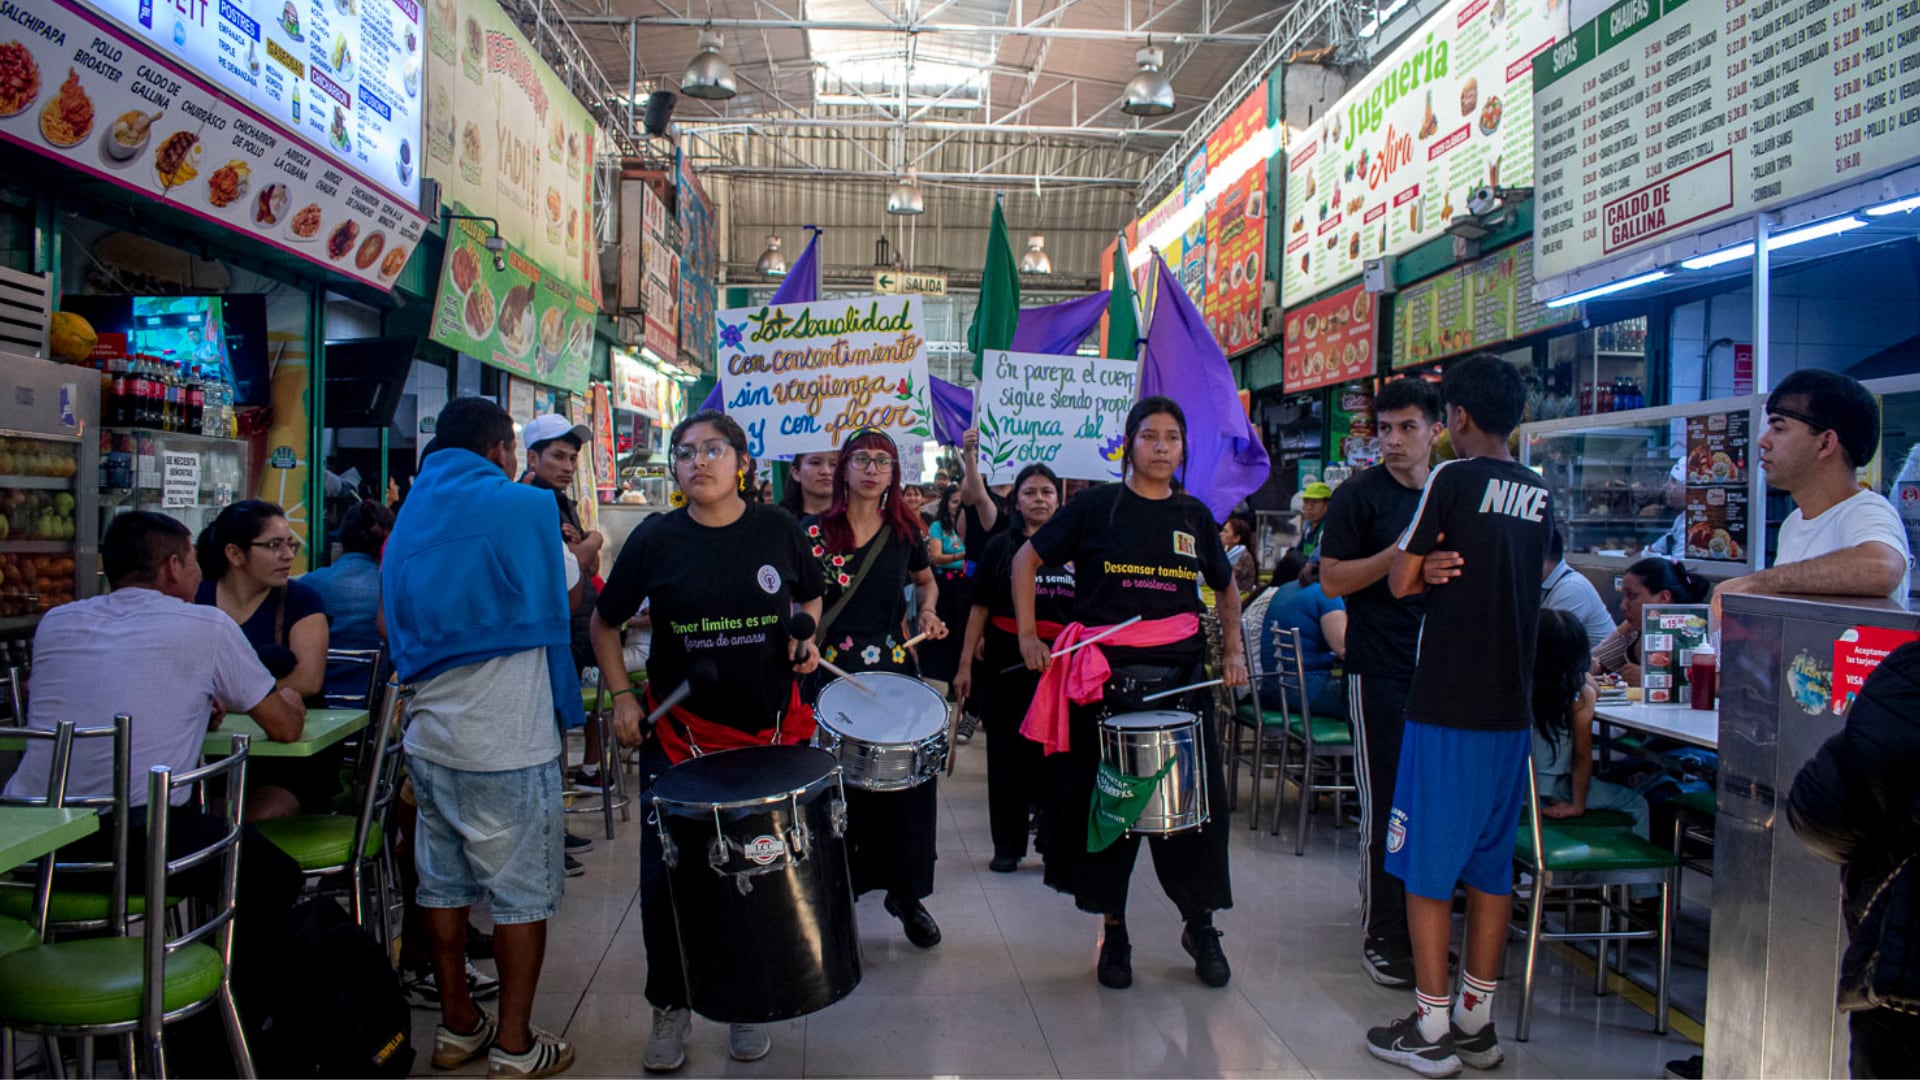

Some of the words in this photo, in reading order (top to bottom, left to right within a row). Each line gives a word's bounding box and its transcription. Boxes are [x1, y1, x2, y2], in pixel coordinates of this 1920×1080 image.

[0, 3, 66, 47] SALCHIPAPA
[220, 2, 255, 36] POSTRES
[91, 37, 123, 63] POLLO
[1553, 37, 1578, 73] SOPAS
[73, 49, 123, 83] BROASTER
[131, 81, 171, 110] GALLINA
[136, 65, 167, 90] CALDO
[167, 82, 182, 97] DE
[1344, 31, 1448, 152] Jugueria
[181, 100, 227, 130] CHURRASCO
[232, 134, 243, 148] DE
[243, 140, 265, 158] POLLO
[233, 118, 278, 149] CHICHARRON
[274, 157, 284, 169] LA
[283, 163, 309, 182] CUBANA
[284, 148, 305, 166] ARROZ
[1608, 192, 1649, 226] CALDO
[1653, 183, 1671, 207] DE
[1612, 208, 1666, 245] GALLINA
[904, 278, 943, 294] SALIDA
[728, 353, 771, 376] con
[771, 332, 922, 374] consentimiento
[996, 353, 1019, 380] En
[1024, 363, 1076, 393] pareja
[1082, 360, 1097, 384] el
[728, 381, 774, 409] sin
[773, 373, 896, 418] vergüenza
[1050, 387, 1092, 410] siendo
[747, 418, 766, 458] y
[780, 415, 821, 436] con
[825, 398, 917, 448] placer
[999, 415, 1063, 438] nunca
[1073, 414, 1104, 440] del
[173, 455, 196, 466] NECESITA
[1016, 436, 1062, 462] otro
[1479, 478, 1548, 523] NIKE
[1104, 560, 1155, 577] Descansar
[1122, 579, 1132, 588] es
[1134, 578, 1177, 592] resistencia
[745, 616, 758, 628] es
[715, 632, 729, 647] de
[1846, 673, 1864, 685] VISA
